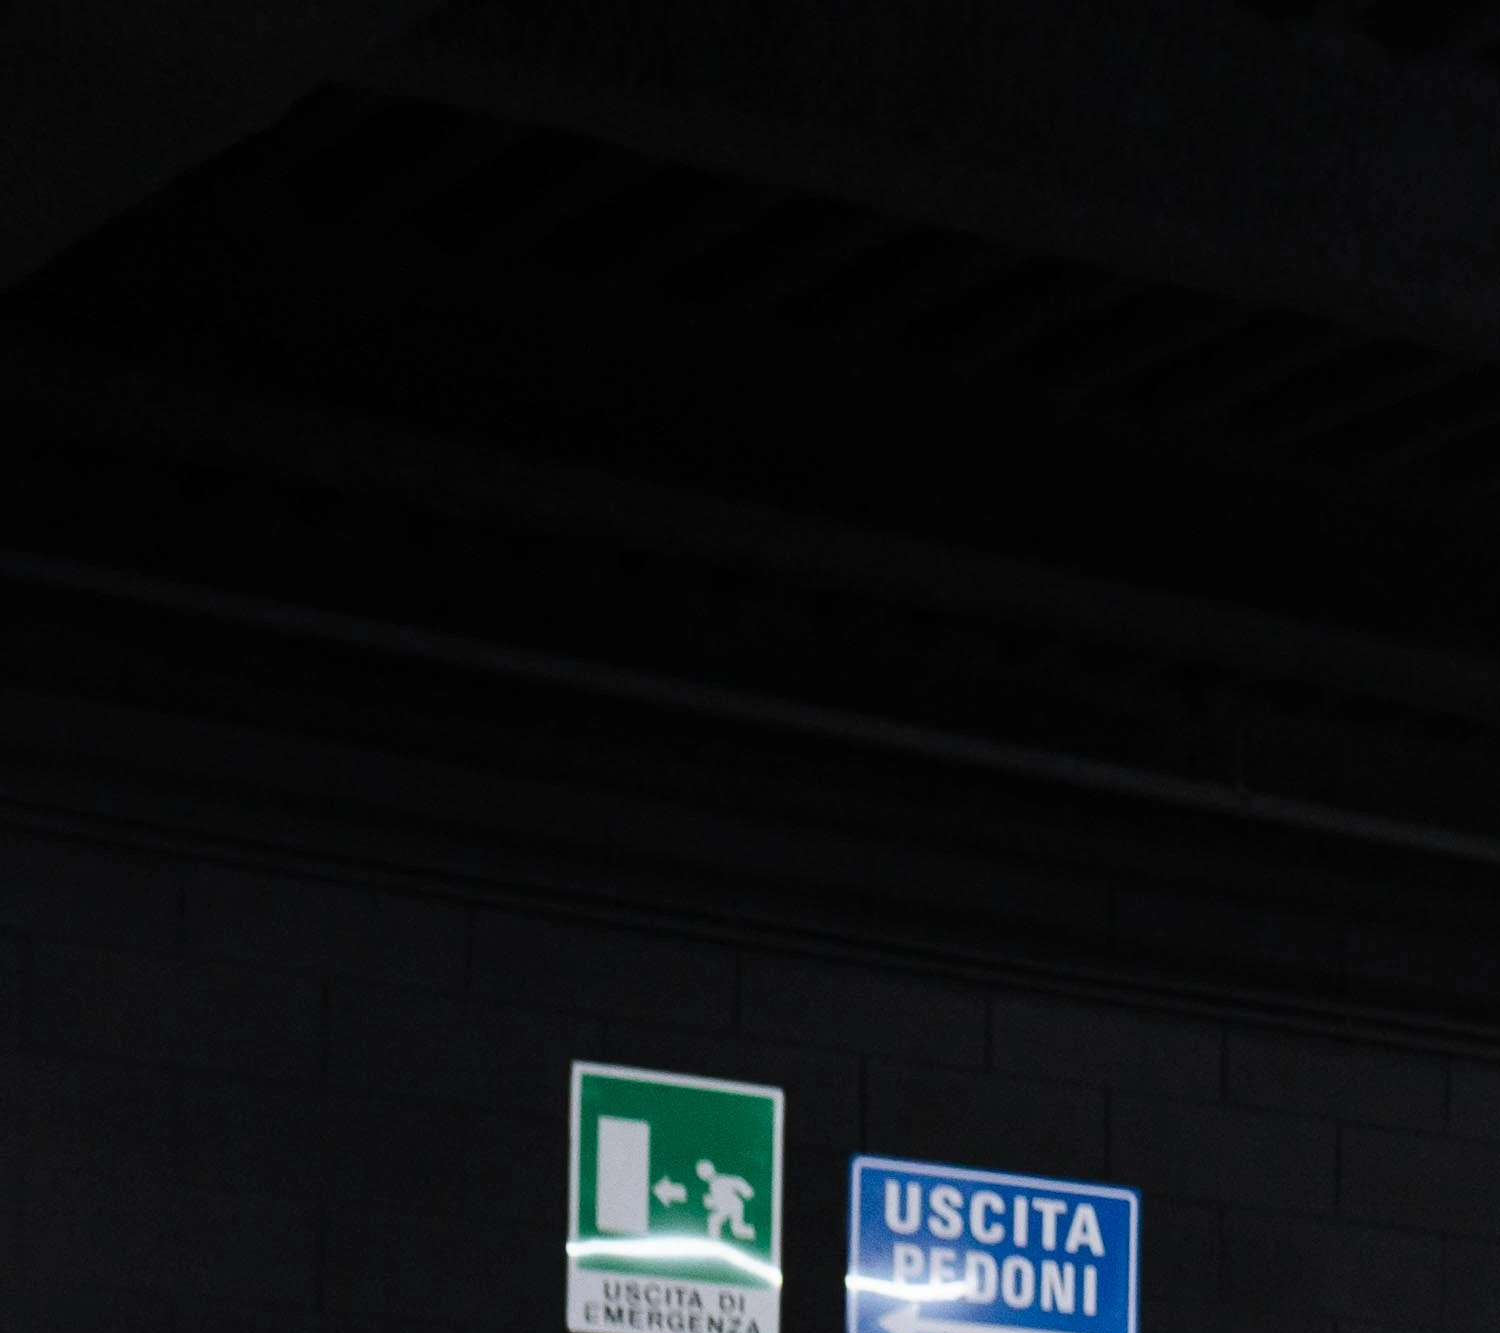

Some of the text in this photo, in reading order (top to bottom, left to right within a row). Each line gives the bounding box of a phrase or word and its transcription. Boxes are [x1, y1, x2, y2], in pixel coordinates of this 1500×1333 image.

[884, 1178, 1105, 1257] USCITA
[603, 1280, 745, 1313] USCITA DI
[893, 1243, 1098, 1316] PEDONI
